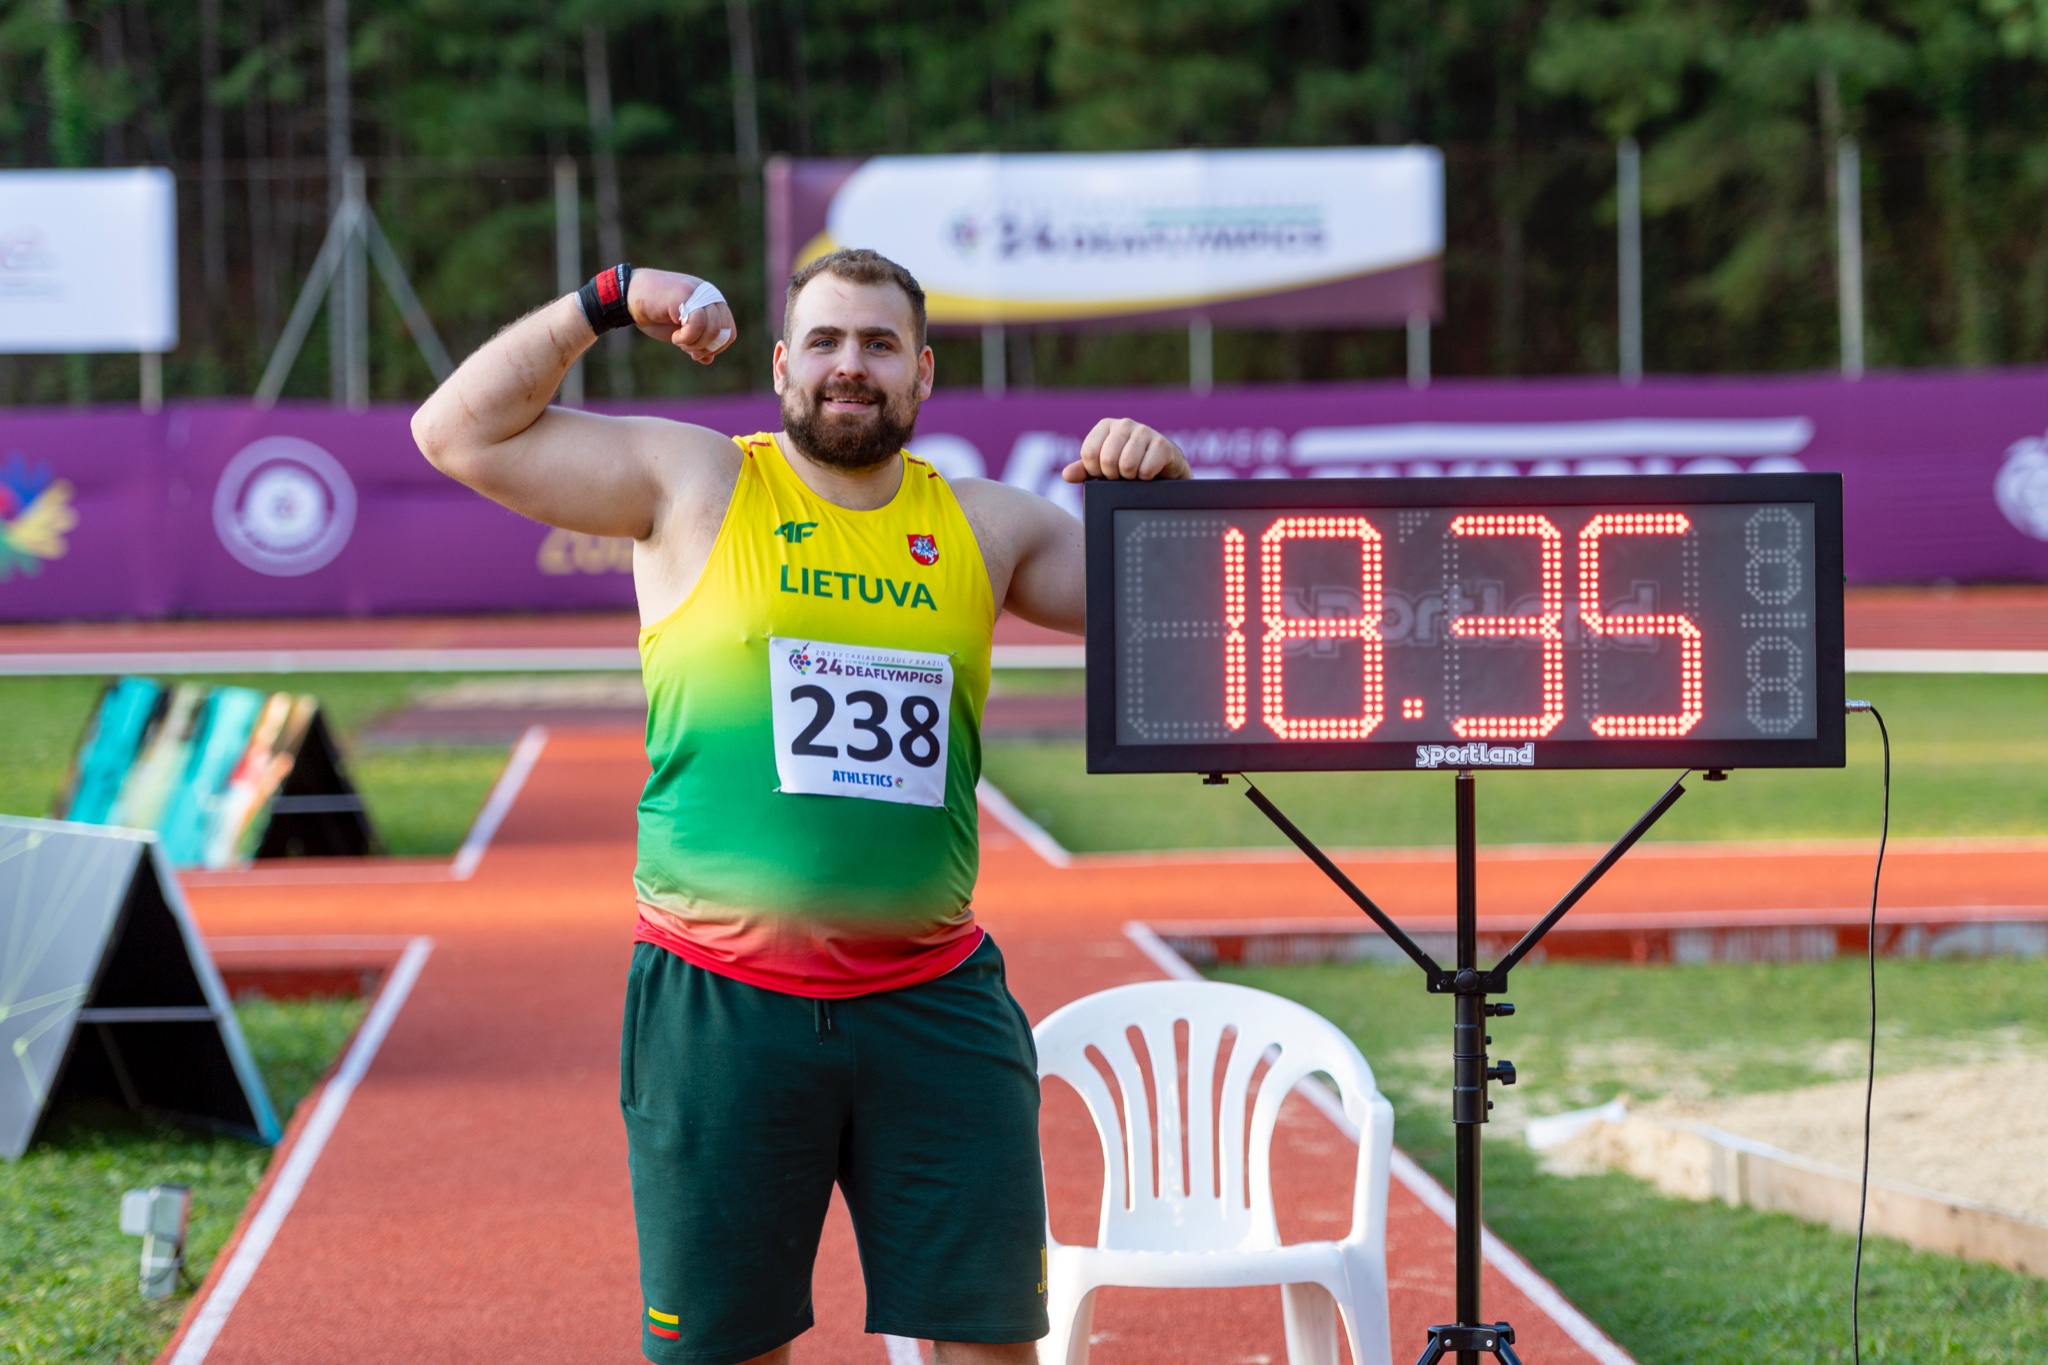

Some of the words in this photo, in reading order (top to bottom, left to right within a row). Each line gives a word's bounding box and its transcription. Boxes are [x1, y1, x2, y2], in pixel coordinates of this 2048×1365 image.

[780, 564, 938, 611] LIETUVA
[1224, 514, 1703, 740] 18.35
[815, 649, 837, 658] 2021
[845, 652, 876, 662] CAXIAS
[891, 656, 907, 664] SUL
[915, 658, 944, 667] BRAZIL
[815, 657, 843, 676] 24
[845, 665, 943, 685] DEAFLYMPICS
[790, 684, 940, 768] 238
[832, 769, 893, 788] ATHLETICS
